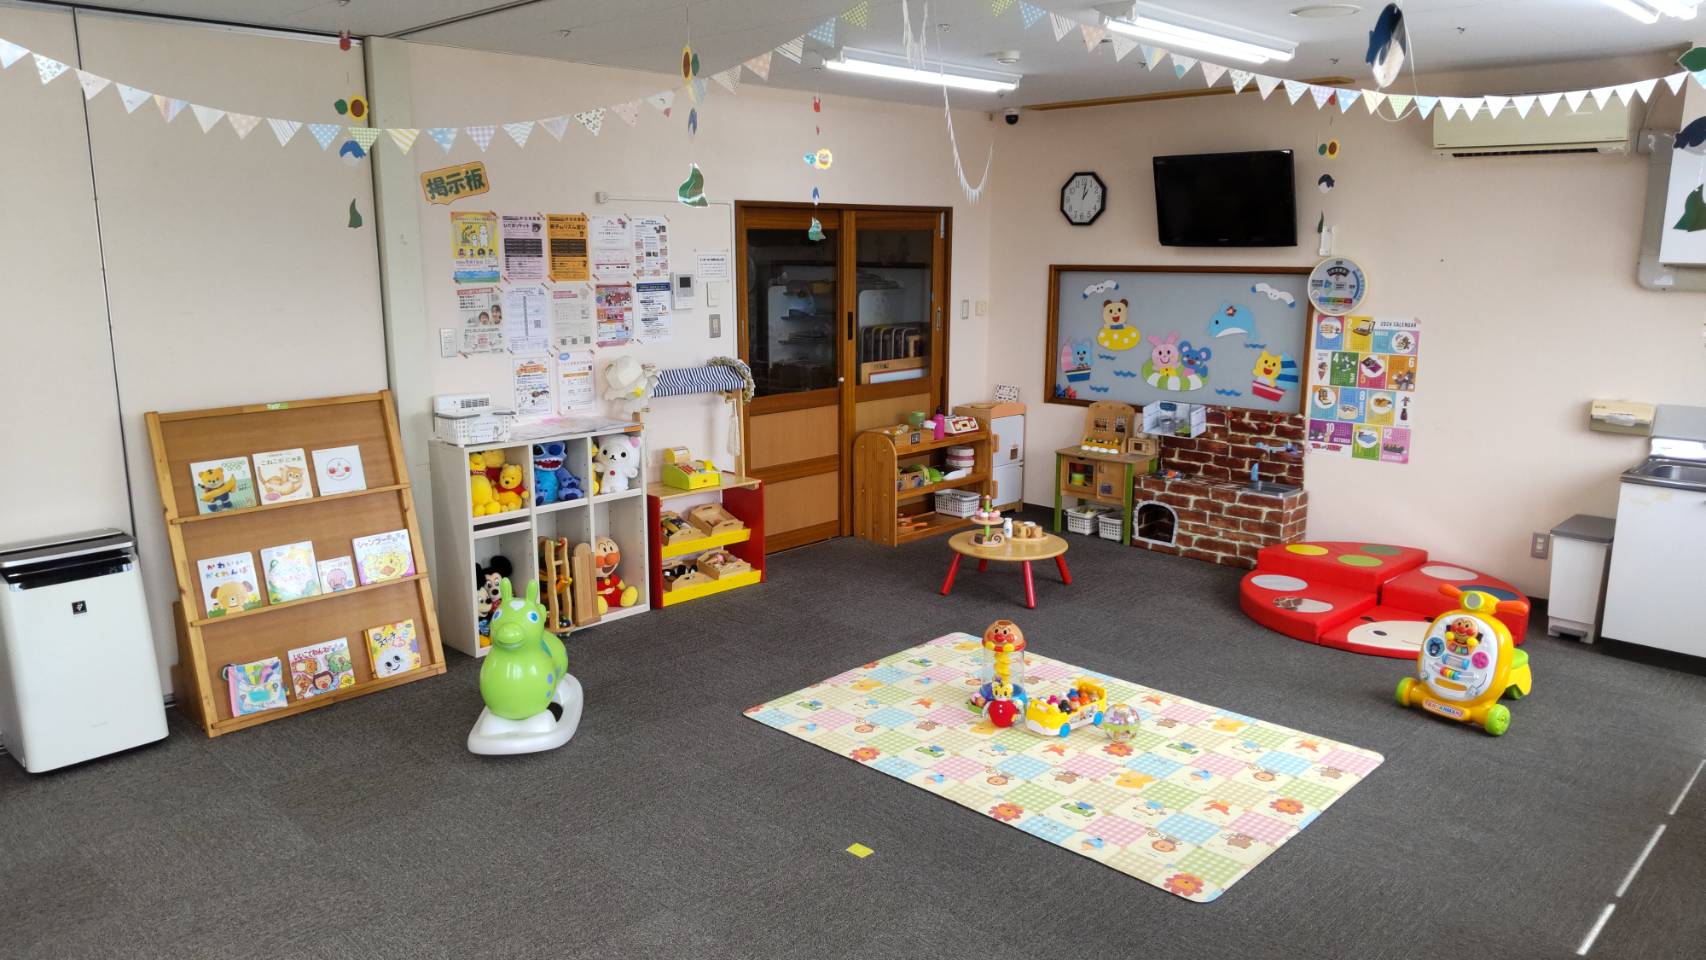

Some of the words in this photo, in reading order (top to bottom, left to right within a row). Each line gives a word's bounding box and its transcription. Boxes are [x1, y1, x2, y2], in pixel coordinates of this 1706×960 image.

[426, 168, 485, 199] 掲示板
[1326, 422, 1335, 433] 10
